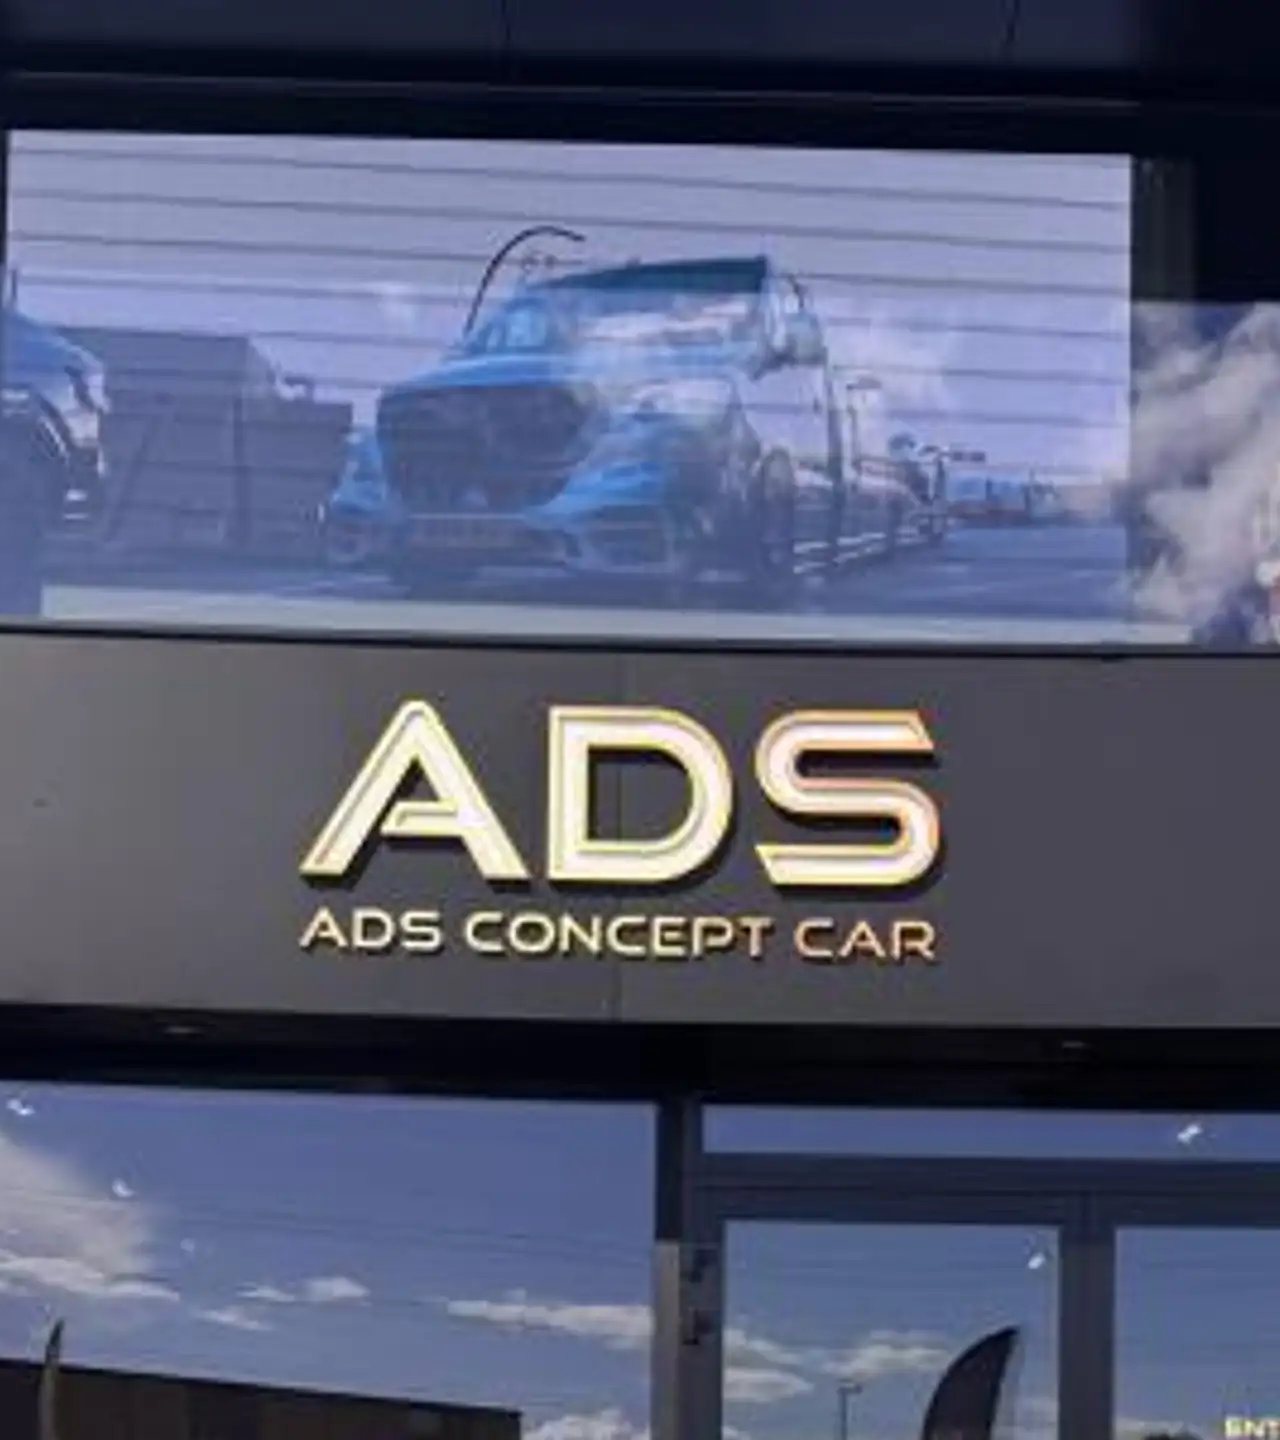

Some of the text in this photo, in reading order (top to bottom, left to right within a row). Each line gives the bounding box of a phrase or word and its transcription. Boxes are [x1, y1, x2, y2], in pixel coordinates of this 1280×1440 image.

[298, 700, 942, 887] ADS
[299, 907, 937, 961] ADS CONCEPT CAR
